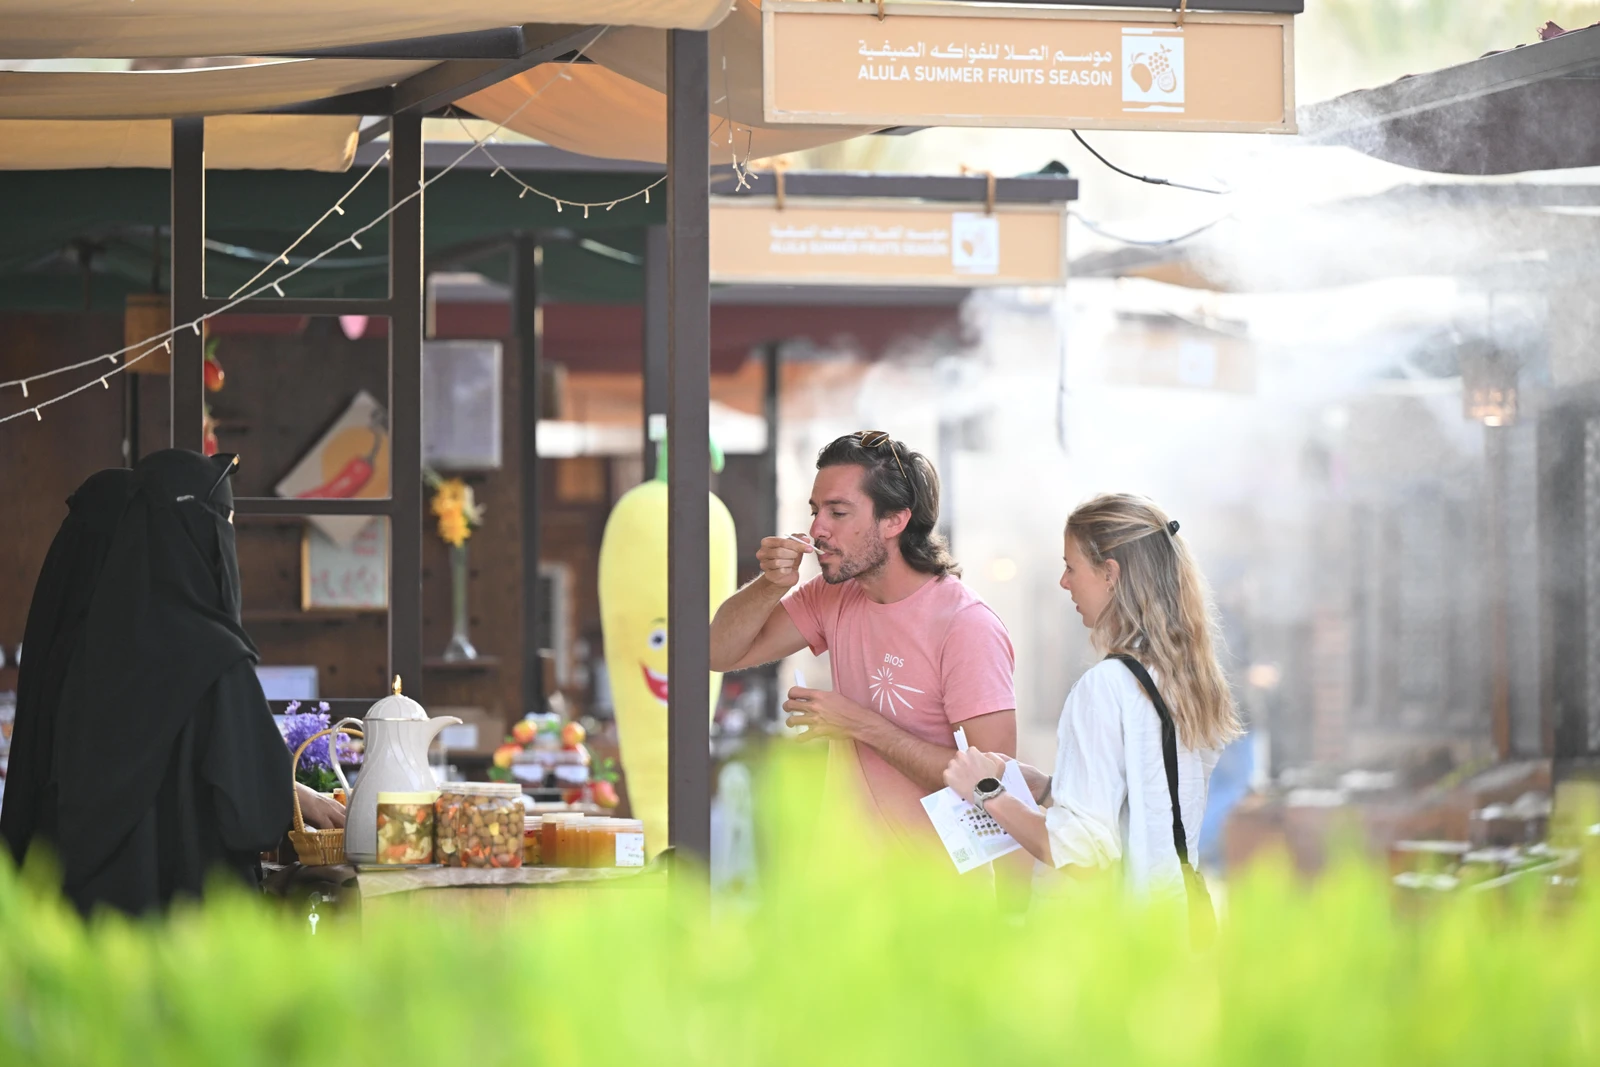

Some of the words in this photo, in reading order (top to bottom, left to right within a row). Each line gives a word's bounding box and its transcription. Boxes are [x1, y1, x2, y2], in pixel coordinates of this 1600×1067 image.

[858, 39, 926, 62] الصيفية
[929, 42, 1000, 64] للفواكه
[1003, 44, 1049, 61] العلا
[1053, 50, 1112, 68] موسم
[858, 64, 910, 80] ALULA
[914, 65, 984, 83] SUMMER
[988, 67, 1045, 84] FRUITS
[1048, 69, 1113, 86] SEASON
[884, 652, 905, 668] BIOS
